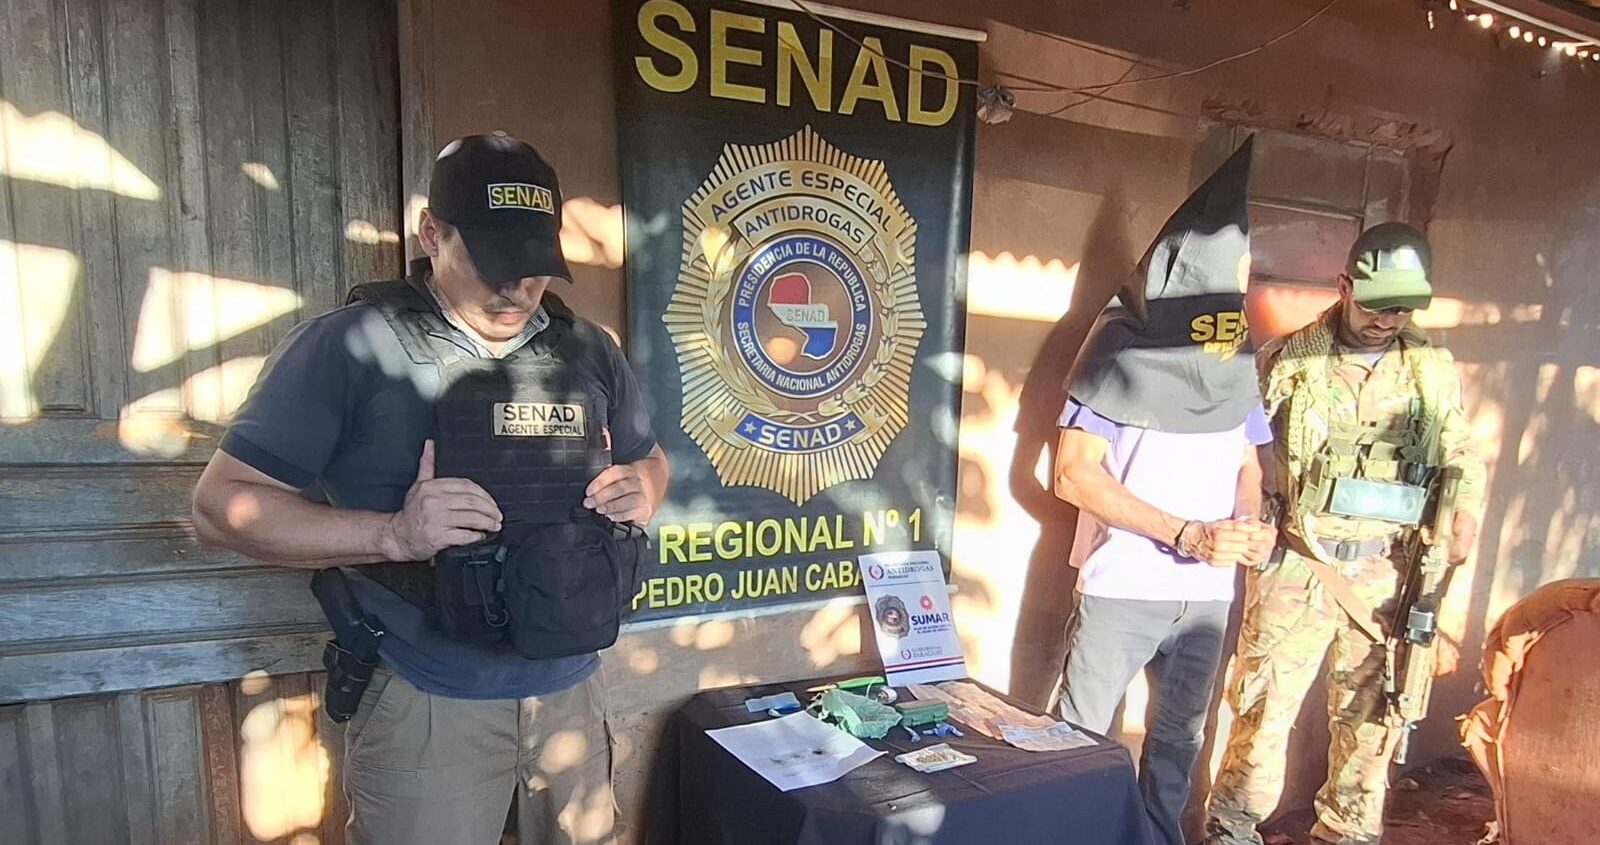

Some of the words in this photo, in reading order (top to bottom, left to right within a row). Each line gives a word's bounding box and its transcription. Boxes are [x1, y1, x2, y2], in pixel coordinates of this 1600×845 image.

[634, 0, 959, 127] SENAD
[491, 186, 552, 210] SENAD
[711, 170, 792, 222] AGENTE
[801, 170, 893, 233] ESPECIAL
[744, 206, 865, 244] ANTIDROGAS
[738, 244, 793, 307] PRESIDENCIA
[795, 242, 810, 255] DE
[813, 244, 826, 260] LA
[828, 251, 867, 312] REPUBLICA
[785, 309, 826, 323] SENAD
[737, 322, 775, 382] SECRETARIA
[776, 374, 826, 392] NACIONAL
[826, 323, 867, 384] ANTIDROGAS
[503, 404, 576, 422] SENAD
[501, 424, 540, 435] AGENTE
[543, 425, 582, 436] ESPECIAL
[758, 423, 843, 448] SENAD
[659, 514, 854, 564] REGIONAL
[908, 508, 921, 542] 1
[731, 569, 798, 599] JUAN
[911, 612, 950, 625] SUMAR
